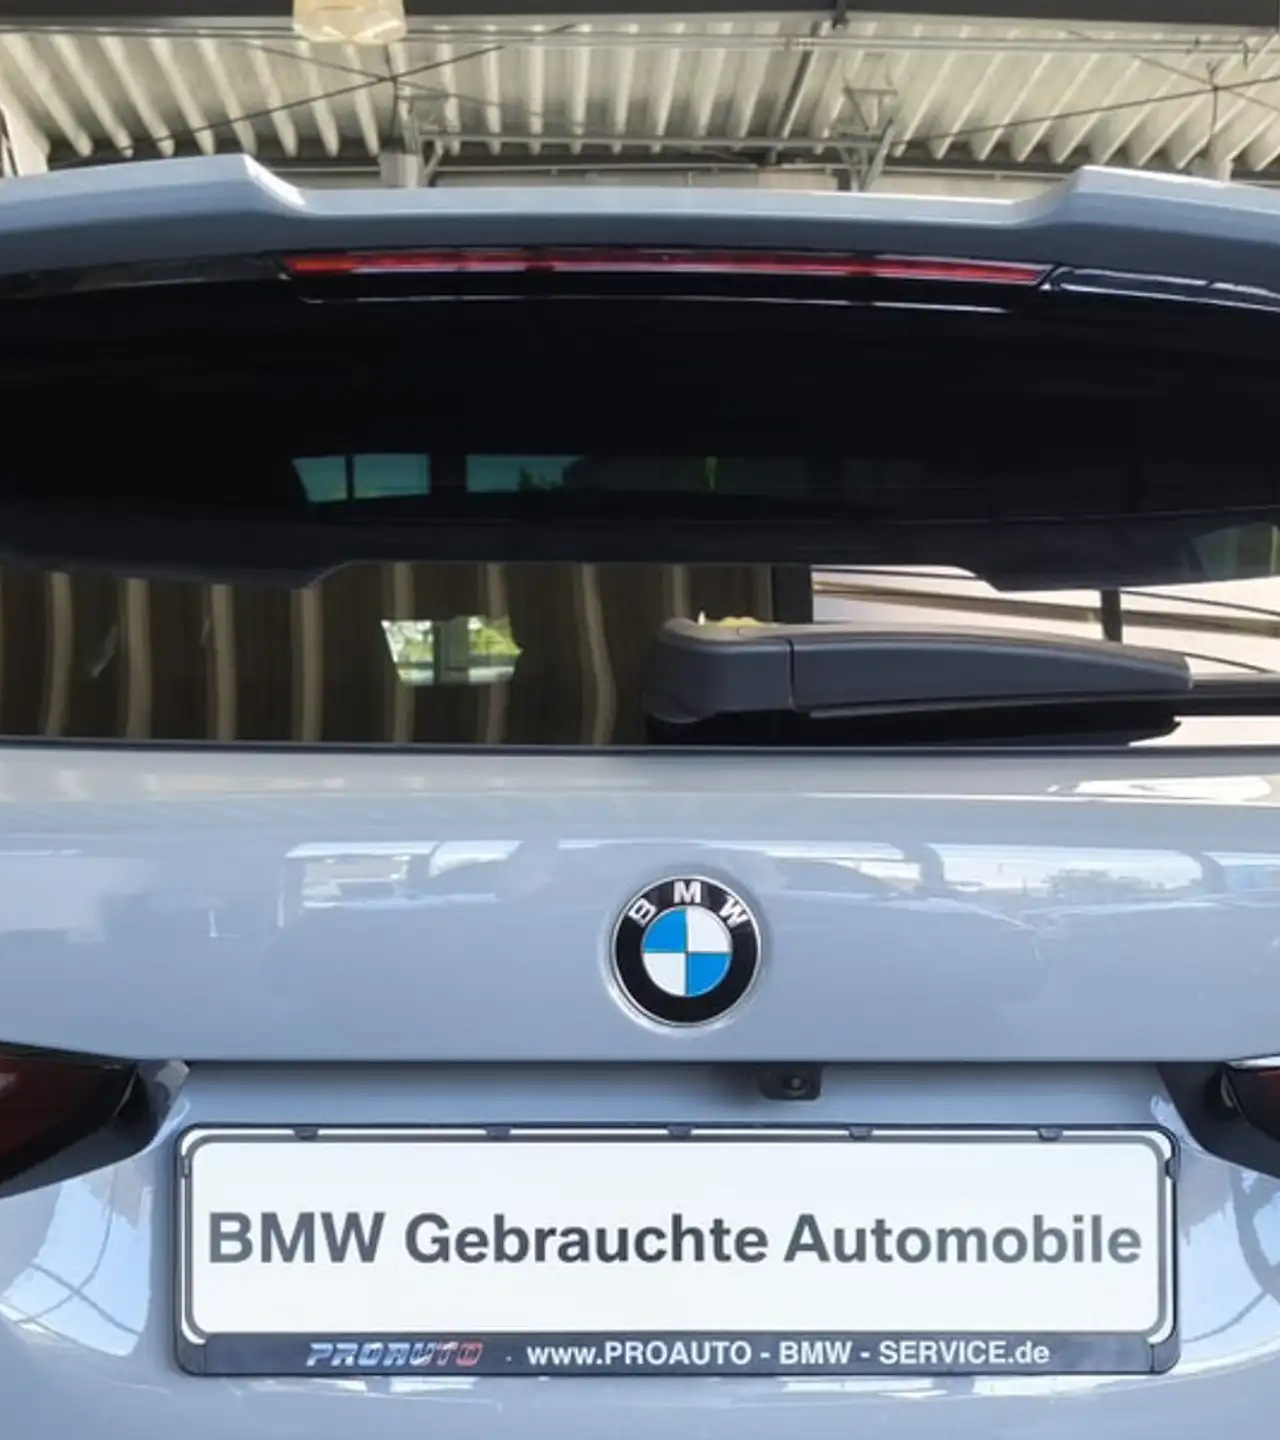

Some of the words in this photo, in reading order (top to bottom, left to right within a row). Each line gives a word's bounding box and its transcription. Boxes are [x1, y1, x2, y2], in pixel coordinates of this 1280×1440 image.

[628, 880, 751, 928] BMW
[208, 1211, 386, 1263] BMW
[405, 1212, 769, 1264] Gebrauchte
[783, 1212, 1141, 1264] Automobile
[305, 1341, 484, 1367] PROAUTO
[526, 1340, 753, 1366] www.PROAUTO
[778, 1340, 854, 1366] BMW
[877, 1340, 1051, 1366] SERVICE.de
